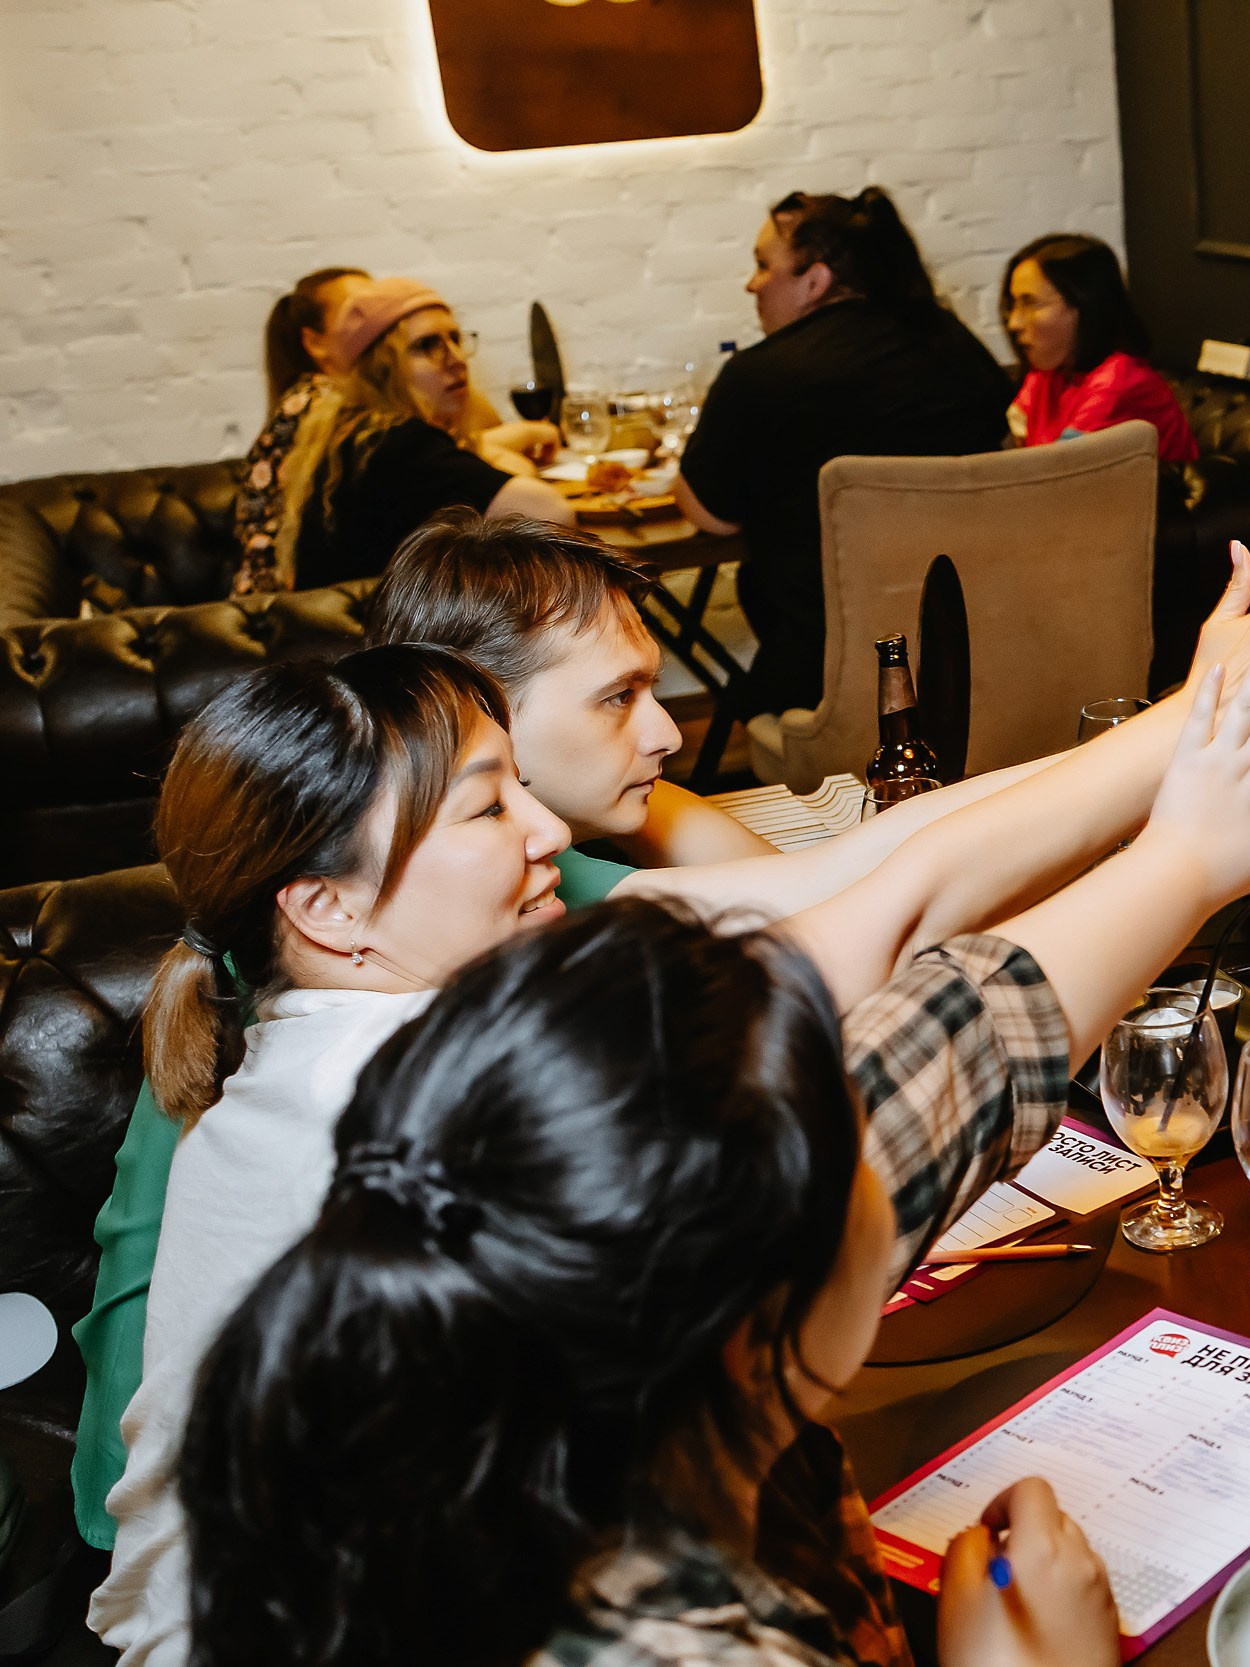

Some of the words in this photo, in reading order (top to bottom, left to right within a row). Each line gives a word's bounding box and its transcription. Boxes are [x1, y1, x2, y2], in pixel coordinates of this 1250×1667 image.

[1047, 1144, 1118, 1175] ЗАПИСИ
[1051, 1131, 1097, 1153] ОСТО
[1091, 1150, 1142, 1172] ЛИСТ
[1181, 1354, 1233, 1378] ДЛЯ
[1196, 1344, 1227, 1362] НЕ
